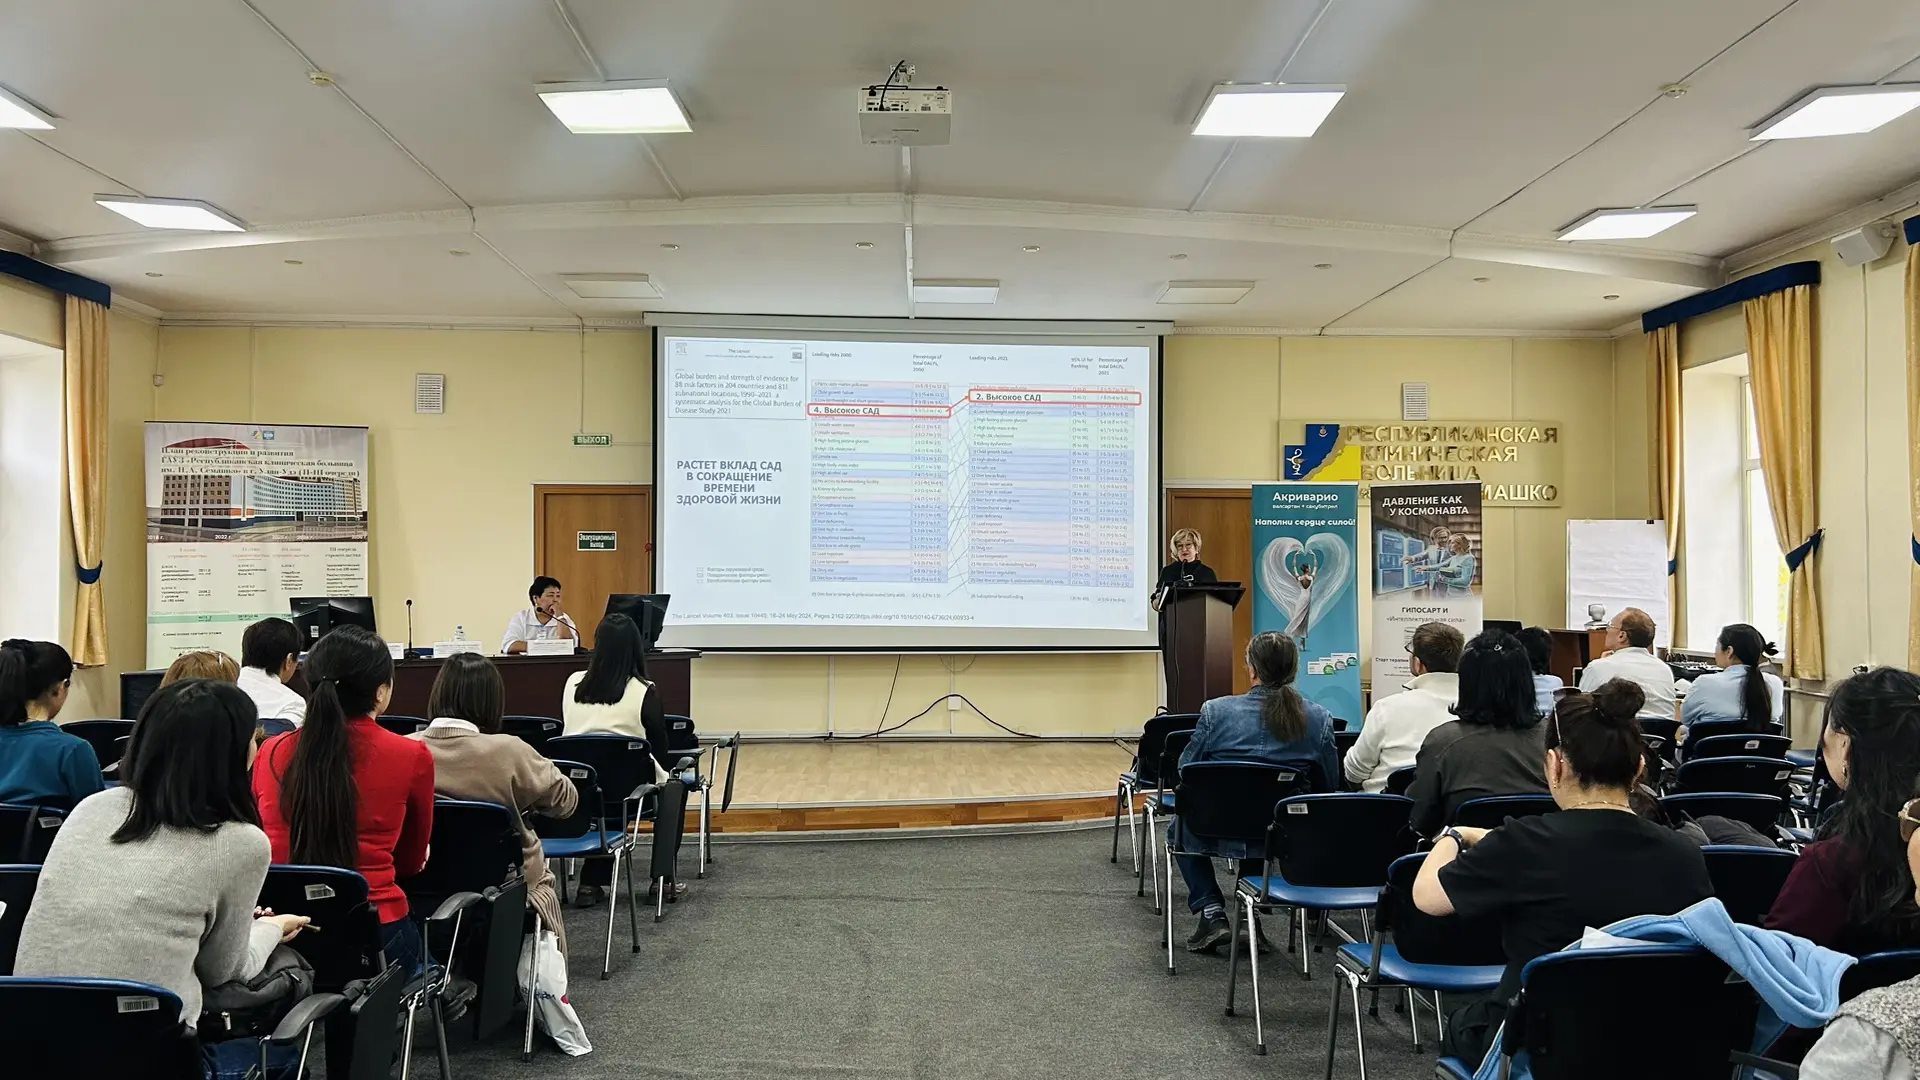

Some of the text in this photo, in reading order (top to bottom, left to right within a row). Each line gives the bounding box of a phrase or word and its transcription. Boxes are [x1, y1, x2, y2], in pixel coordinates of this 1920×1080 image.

[731, 374, 755, 382] strength
[675, 399, 706, 407] systematic
[708, 400, 731, 408] analysis
[1024, 394, 1042, 402] САД
[578, 436, 607, 445] ВЫХОД
[1346, 426, 1558, 444] РЕСПУБЛИКАНСКАЯ
[186, 448, 248, 456] реконструкции
[1360, 445, 1519, 462] КЛИНИЧЕСКАЯ
[677, 460, 782, 472] РАСТЕТ ВКЛАД САД
[687, 472, 773, 483] В СОКРАЩЕНИЕ
[1360, 465, 1481, 481] БОЛЬНИЦА
[704, 484, 755, 493] ВРЕМЕНИ
[676, 493, 781, 506] ЗДОРОВОЙ ЖИЗНИ
[1273, 492, 1339, 503] Акриварио
[1382, 495, 1462, 507] ДАВЛЕНИЕ КАК
[1390, 506, 1469, 516] У КОСМОНАВТА
